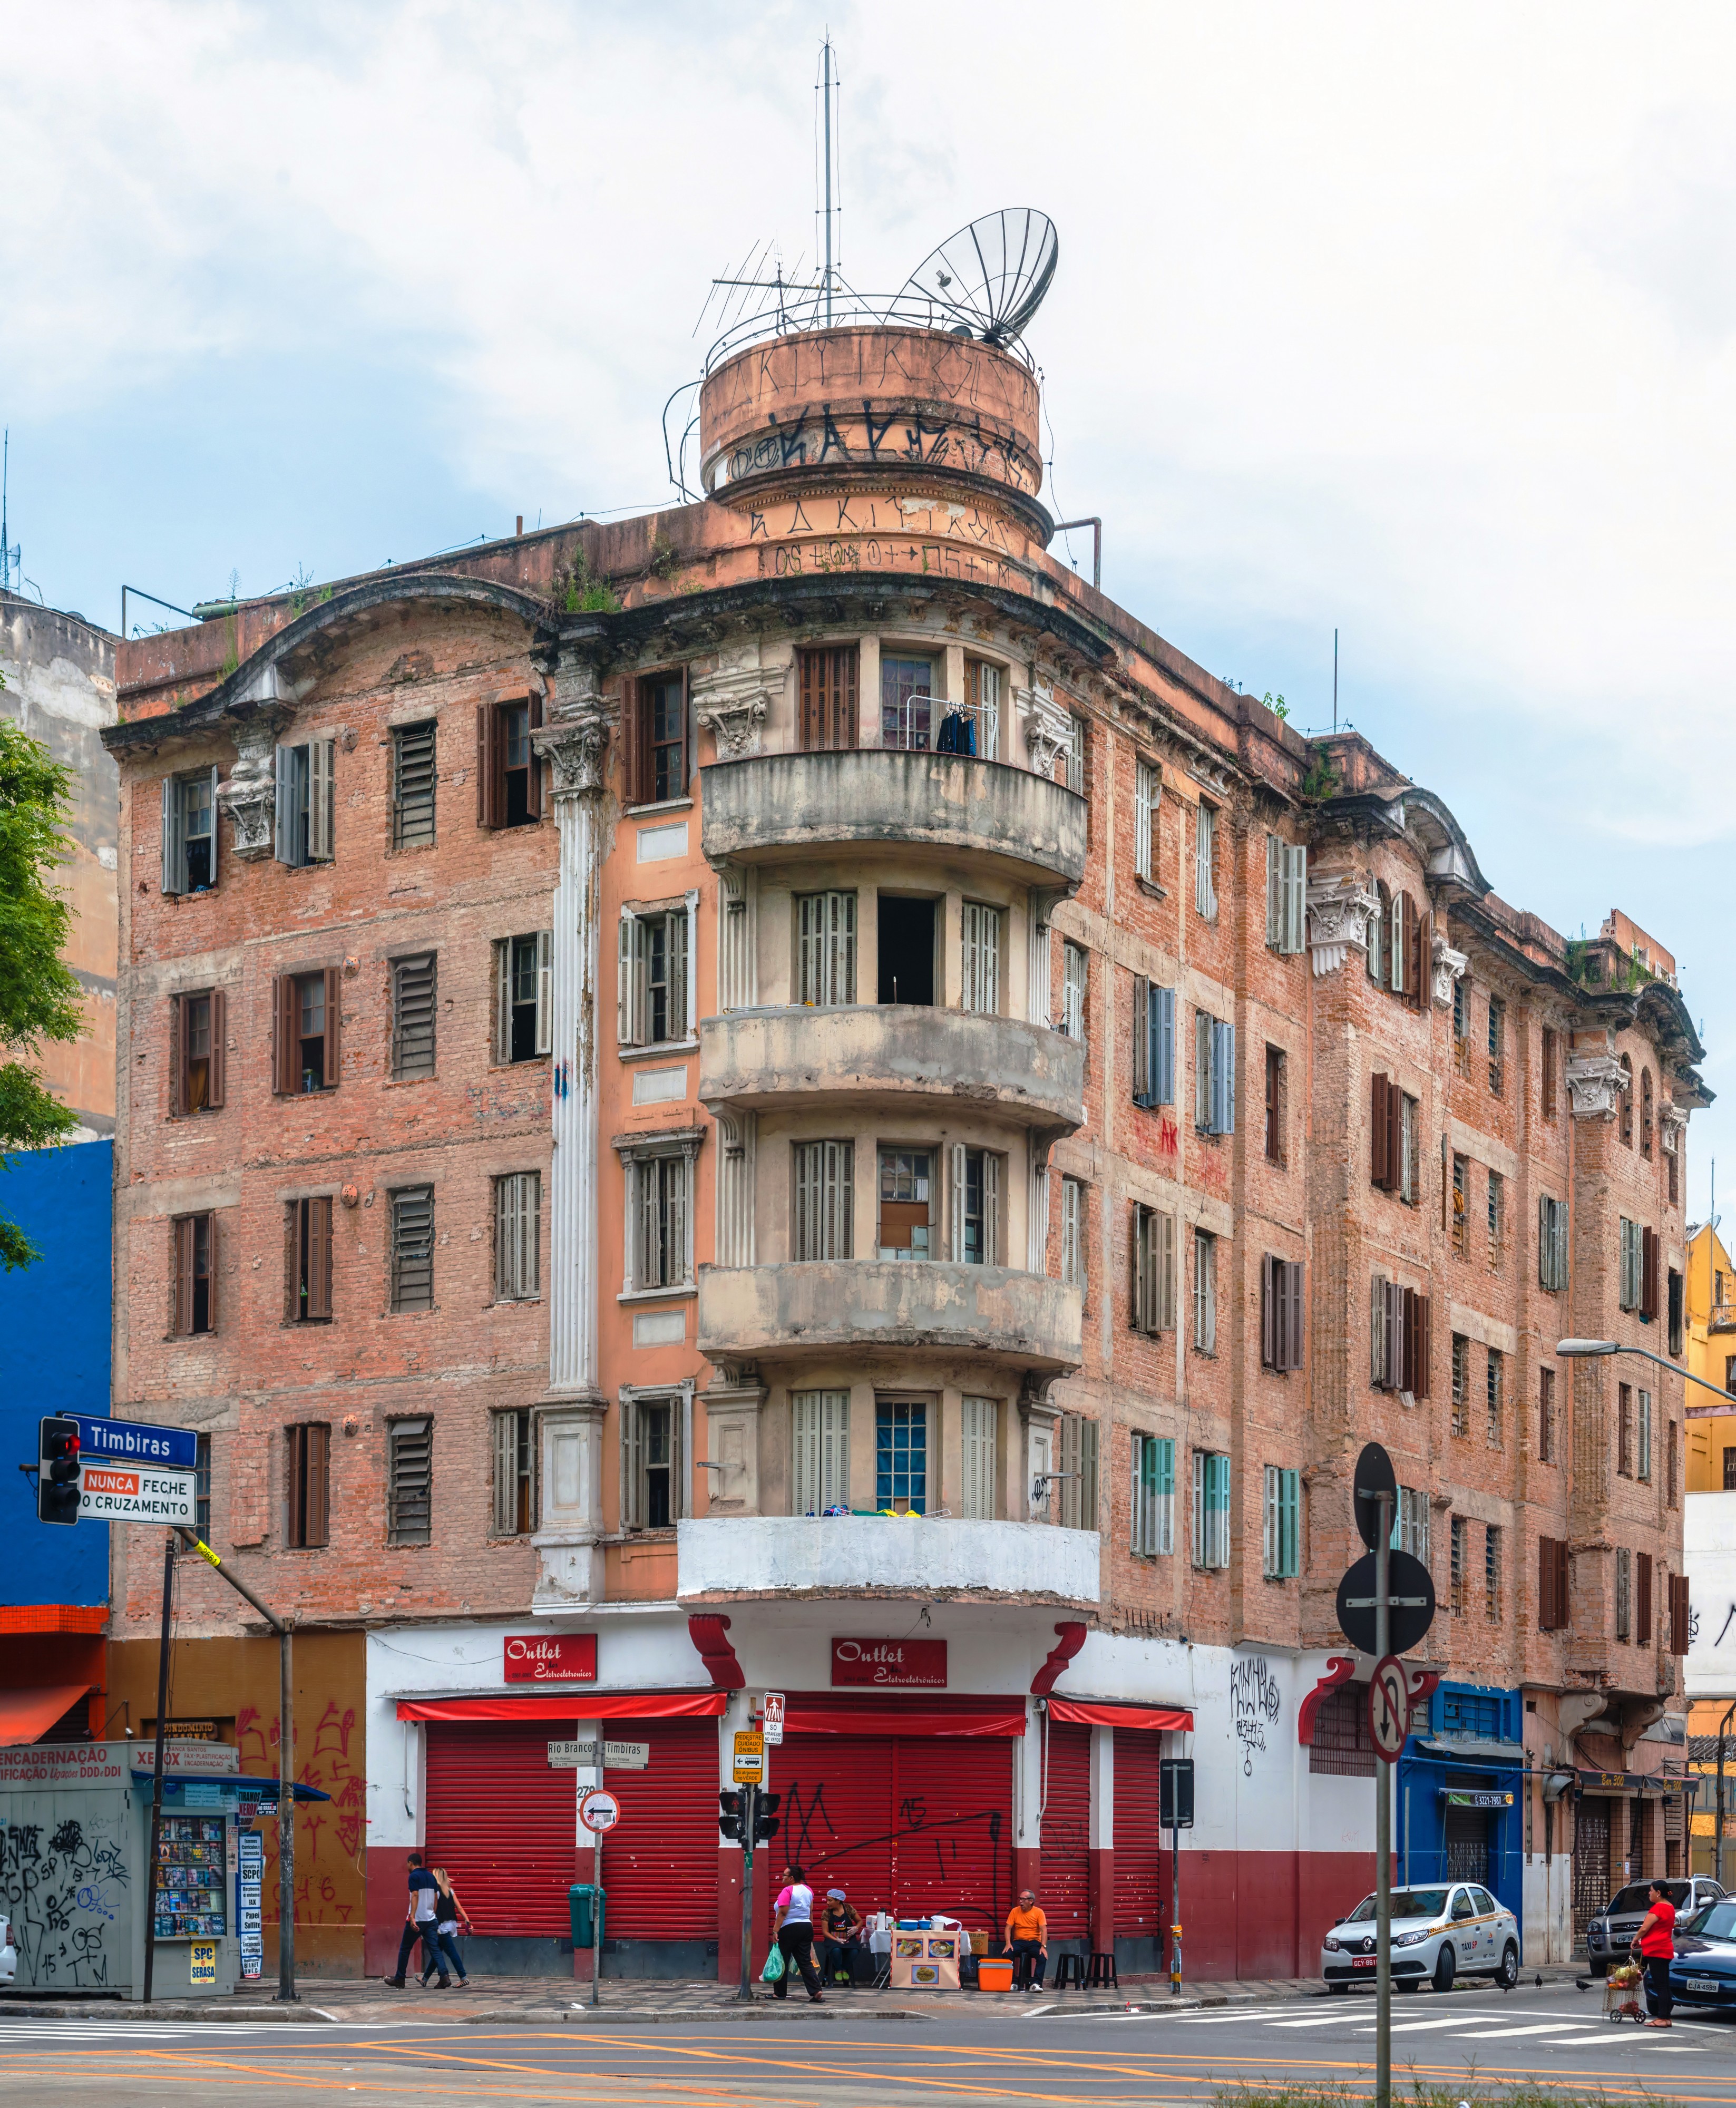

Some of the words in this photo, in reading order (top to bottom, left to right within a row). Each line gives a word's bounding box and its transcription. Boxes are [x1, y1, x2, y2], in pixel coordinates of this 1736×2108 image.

[91, 1426, 170, 1456] Timbiras
[89, 1474, 134, 1491] NUNCA
[143, 1479, 187, 1496] FECHE
[82, 1495, 90, 1508] O
[96, 1496, 188, 1516] CRUZAMENTO
[201, 1548, 217, 1564] 2661
[507, 1639, 562, 1660] Outlet
[836, 1642, 906, 1663] Outlet
[548, 1660, 558, 1668] dos
[873, 1666, 945, 1684] Eletroeletrônicos
[549, 1743, 561, 1753] Rio
[565, 1743, 592, 1753] Branco
[607, 1743, 640, 1754] Timbiras
[136, 1751, 180, 1765] XEOX
[80, 1766, 100, 1778] DDD
[104, 1766, 121, 1778] DDI
[1601, 1773, 1612, 1785] Bar
[1613, 1774, 1624, 1787] 300
[1673, 1780, 1682, 1791] 300
[1472, 1940, 1477, 1949] SP
[194, 1947, 212, 1960] SPC
[192, 1966, 214, 1978] SERASA
